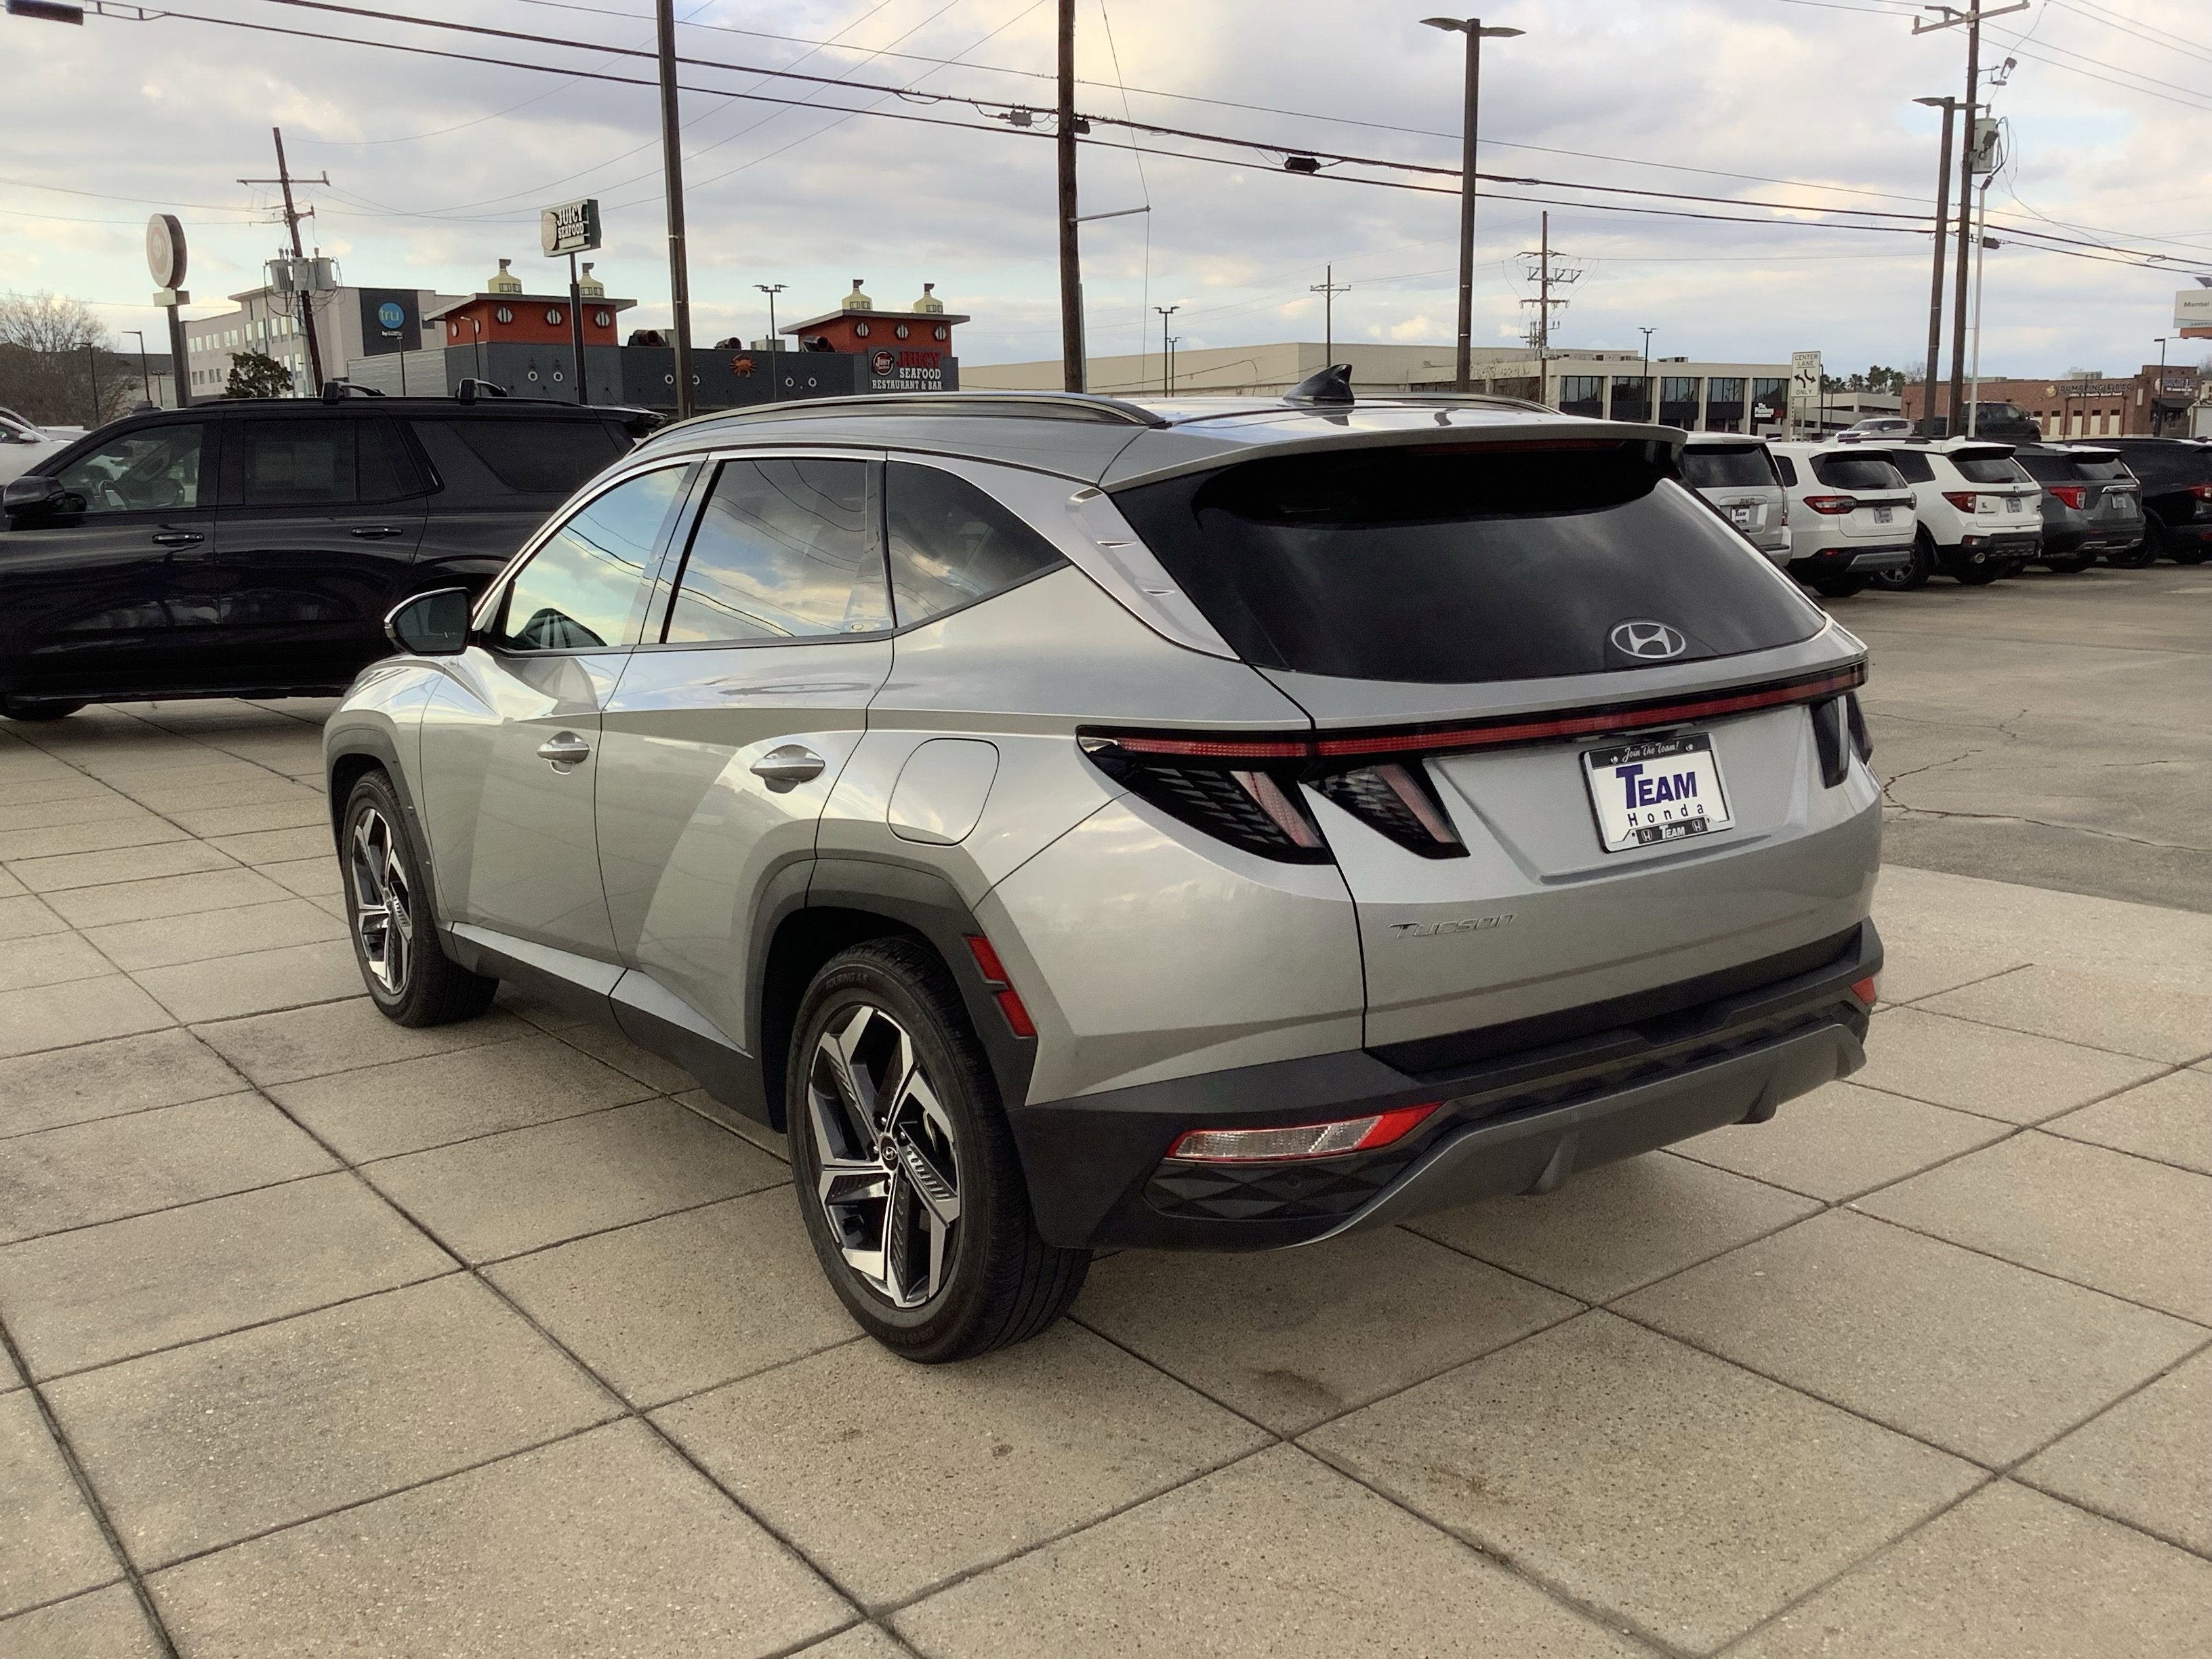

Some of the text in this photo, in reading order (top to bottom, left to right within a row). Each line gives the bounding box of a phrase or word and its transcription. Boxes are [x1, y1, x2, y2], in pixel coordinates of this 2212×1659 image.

[556, 203, 583, 226] JUICY
[558, 222, 584, 239] SEAFOOD
[380, 308, 399, 321] tru
[897, 351, 941, 368] JUICY
[899, 368, 941, 380] SEAFOOD
[872, 380, 943, 390] RESTAURANT & BAR
[2060, 384, 2104, 392] DUMPING
[1622, 741, 1679, 763] Join The Team!
[1616, 763, 1698, 809] TEAM
[1627, 804, 1704, 827] Honda
[1658, 824, 1686, 840] TEAM
